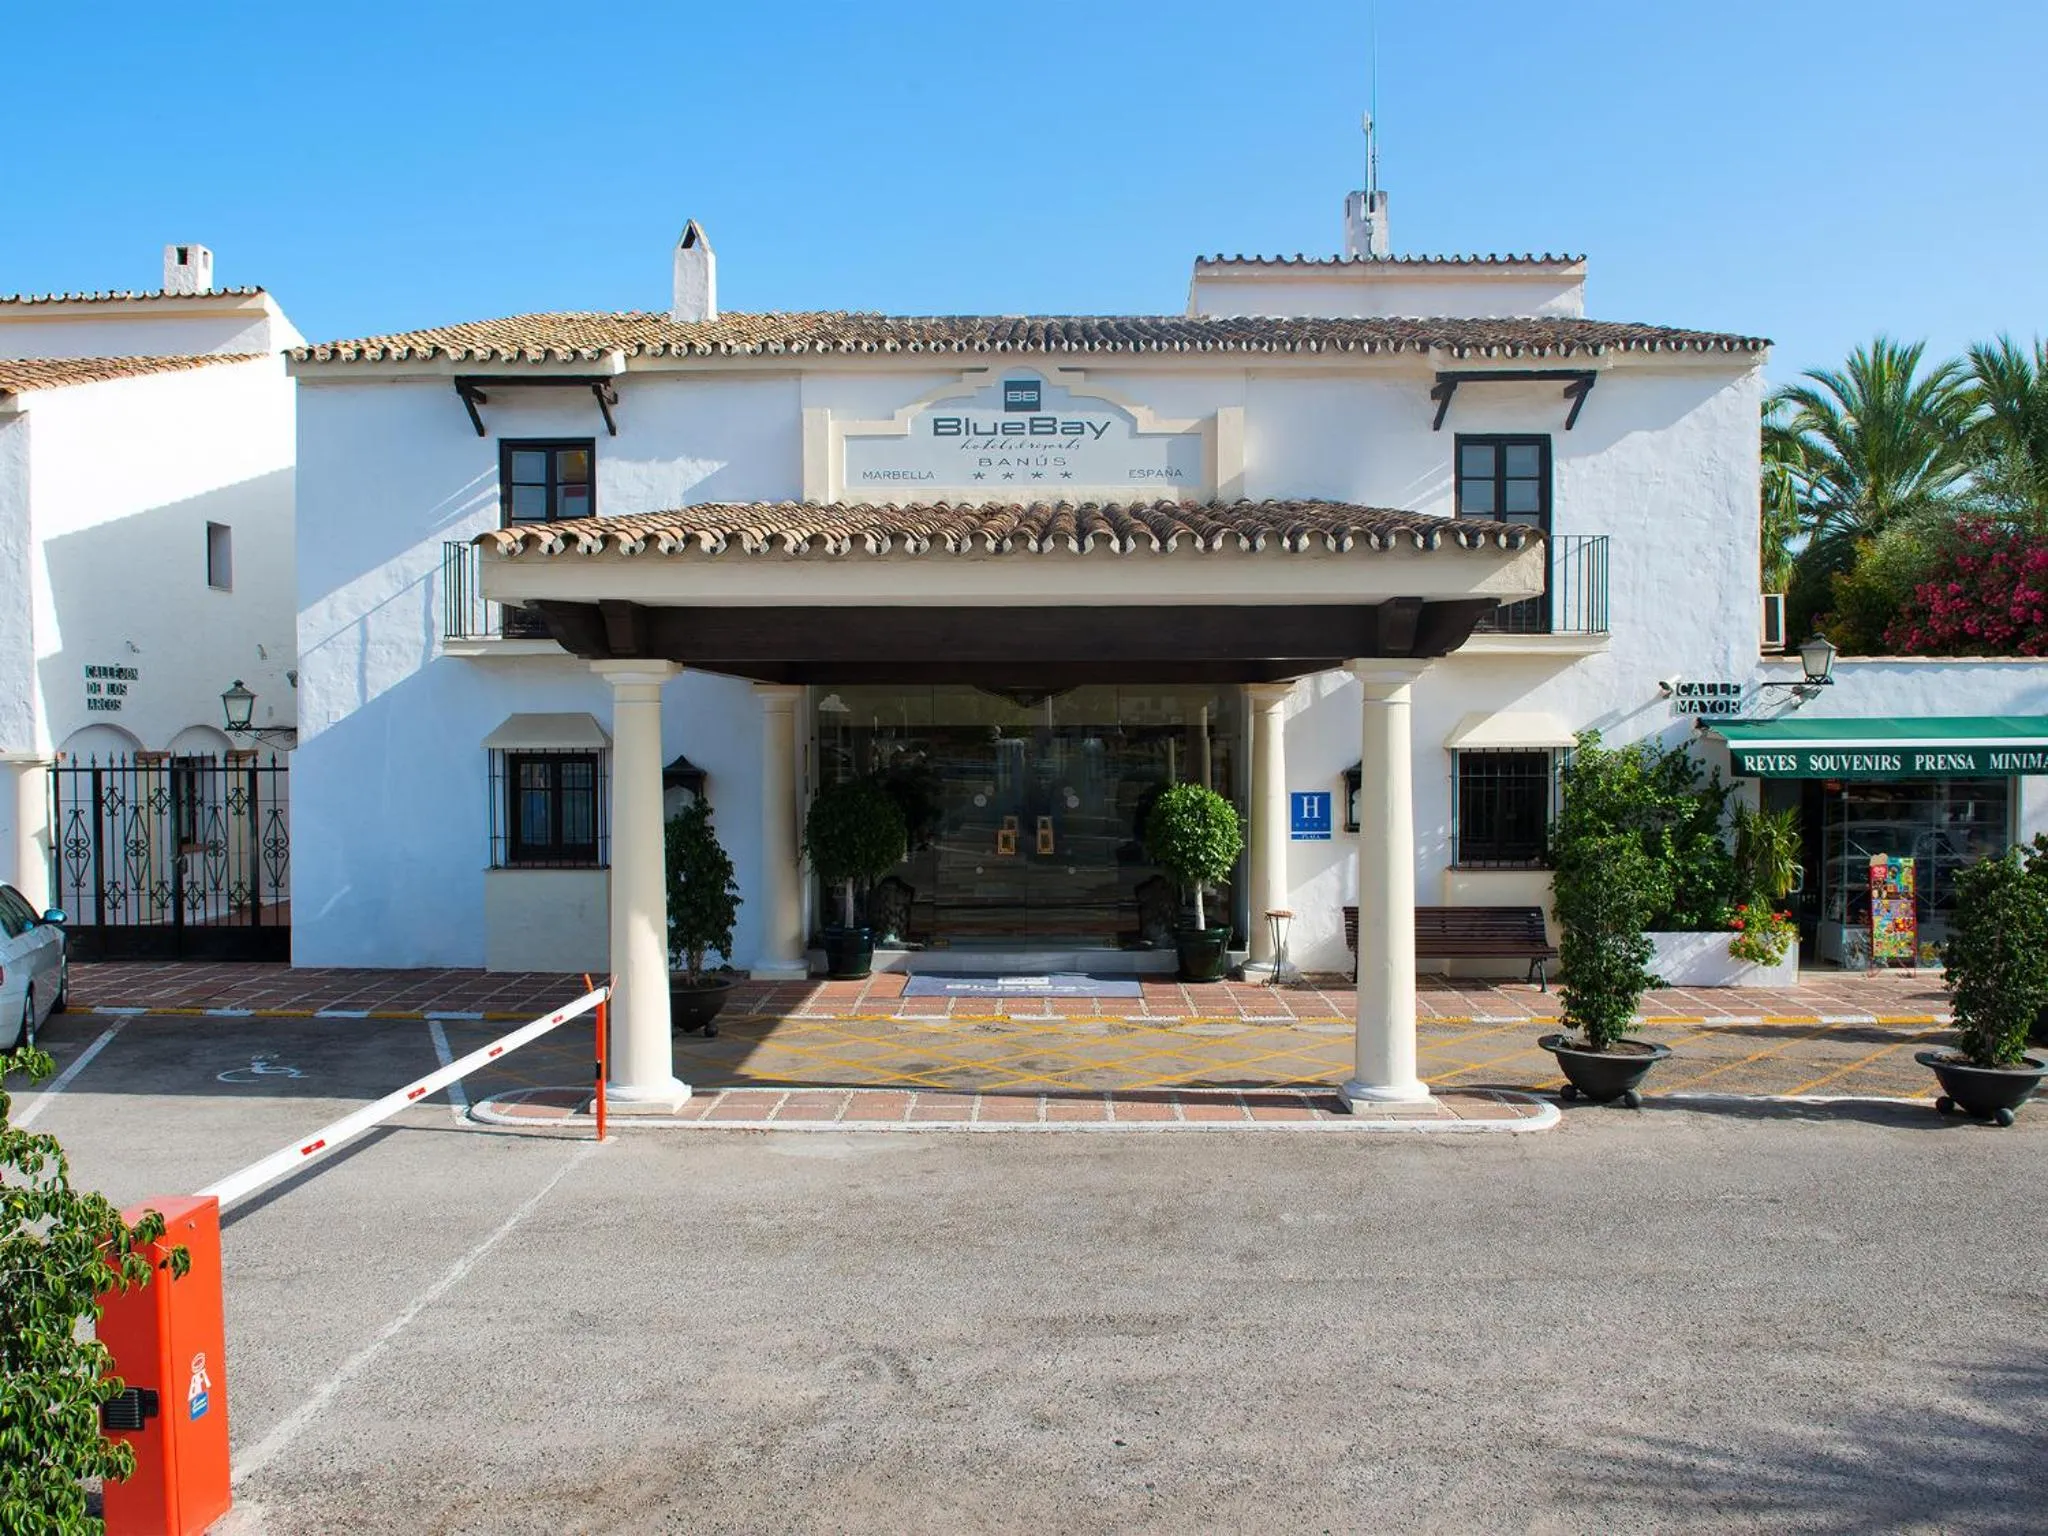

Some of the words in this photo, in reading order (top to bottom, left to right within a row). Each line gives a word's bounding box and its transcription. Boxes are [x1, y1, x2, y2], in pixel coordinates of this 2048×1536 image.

[933, 416, 1111, 441] BlueBay
[978, 454, 1067, 467] BANÚS
[862, 470, 935, 480] MARBELLA
[1128, 466, 1183, 479] ESPAÑA
[107, 682, 128, 696] LOS
[1677, 683, 1741, 697] CALLE
[87, 698, 122, 711] ARCOS
[1677, 699, 1741, 714] MAYOR
[1744, 755, 1797, 771] REYES
[1809, 754, 1901, 771] SOUVENIRS
[1915, 754, 1976, 771] PRENSA
[1301, 795, 1320, 819] H
